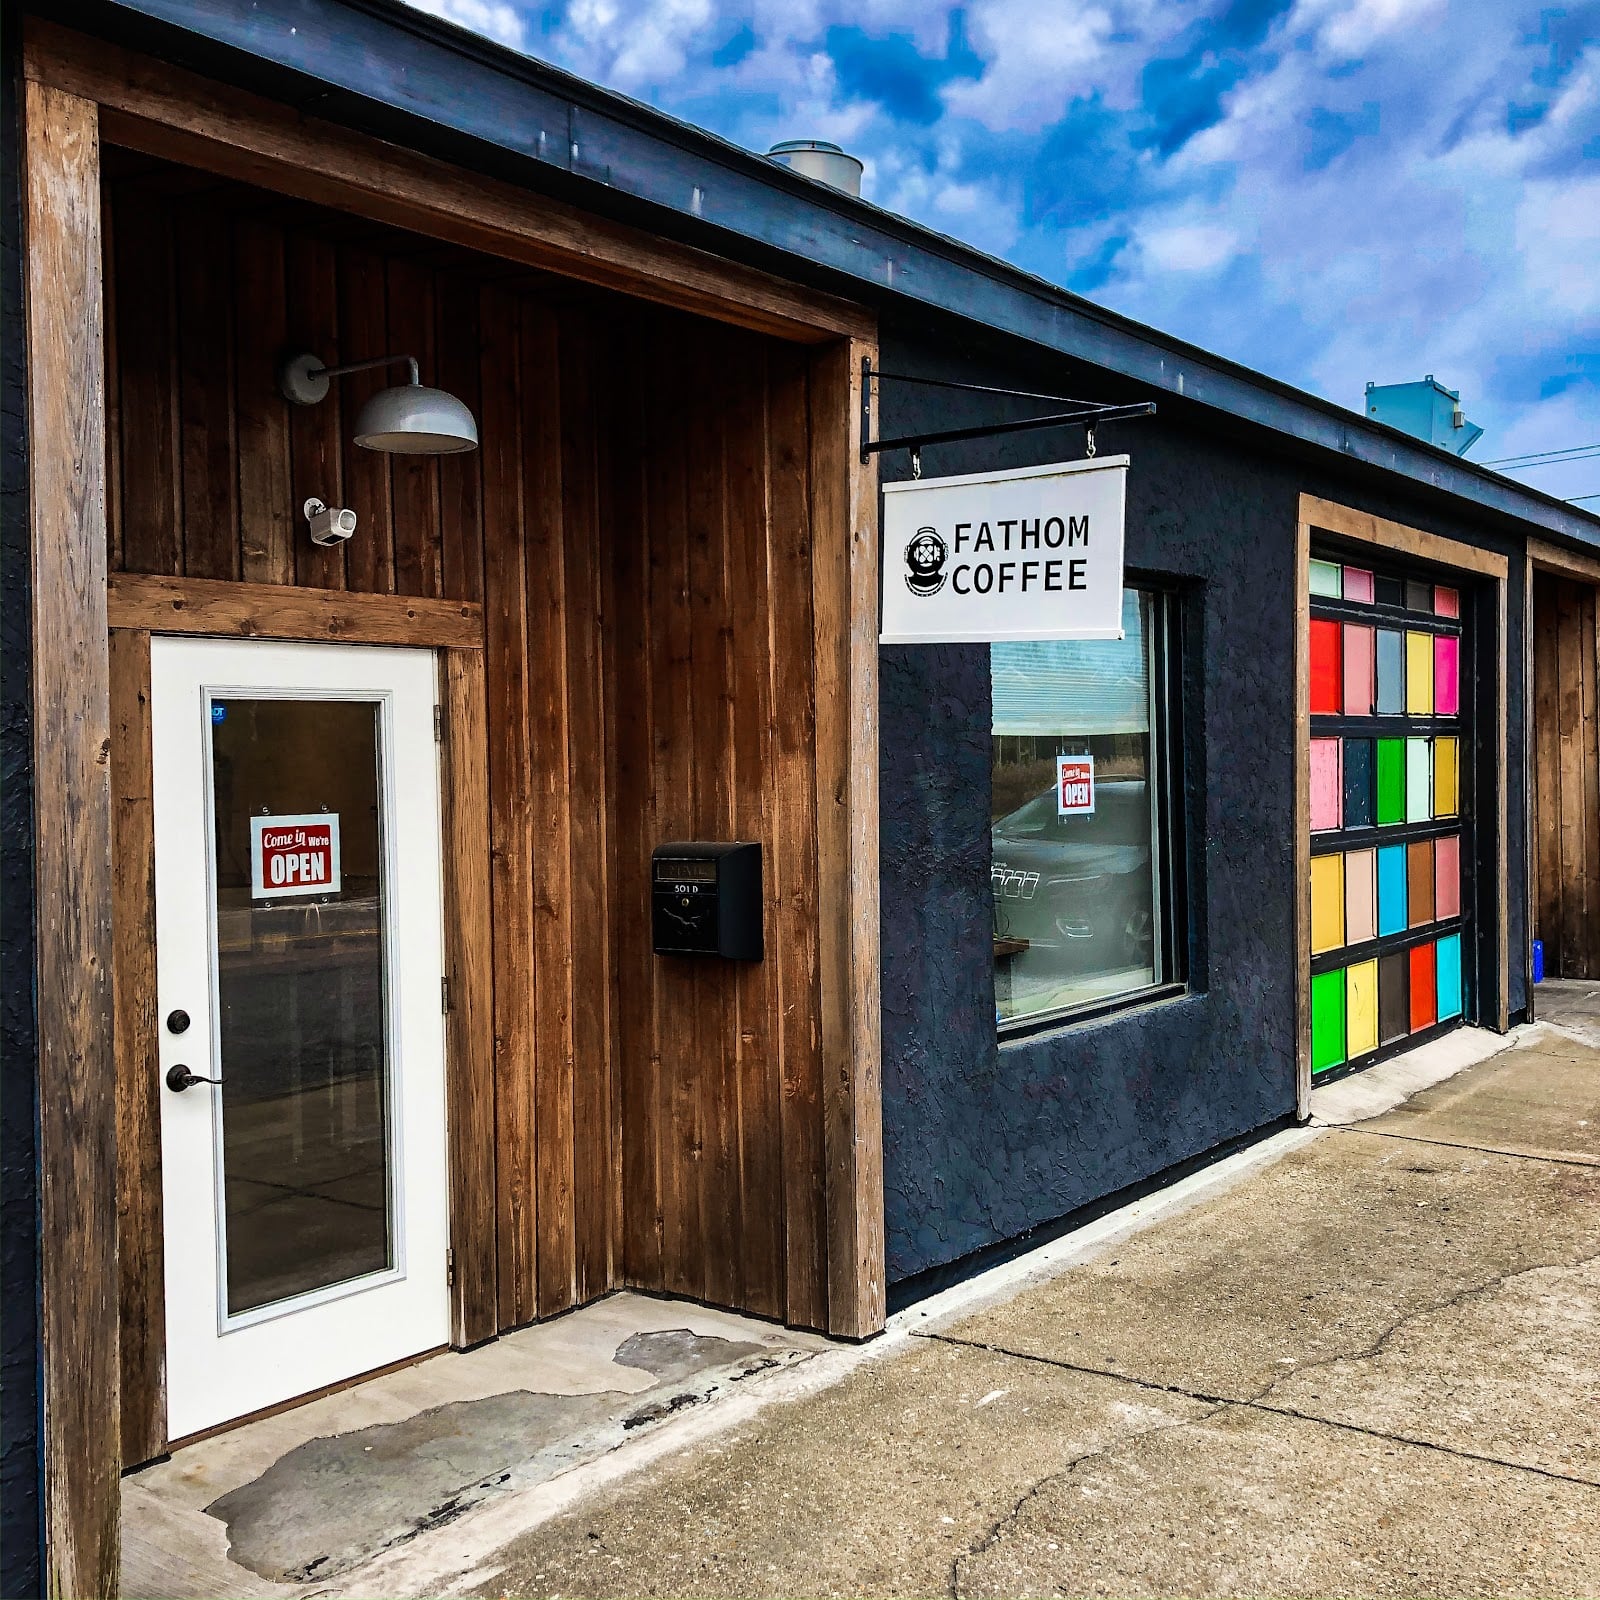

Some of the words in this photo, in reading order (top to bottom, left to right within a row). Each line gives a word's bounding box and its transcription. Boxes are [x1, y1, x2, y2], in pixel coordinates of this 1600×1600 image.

[954, 515, 1089, 553] FATHOM
[952, 559, 1087, 595] COFFEE
[1065, 783, 1088, 805] OPEN
[264, 833, 293, 848] Come
[295, 829, 306, 846] in
[308, 836, 329, 847] We're
[270, 852, 325, 885] OPEN
[674, 885, 690, 893] 501
[692, 885, 698, 893] D
